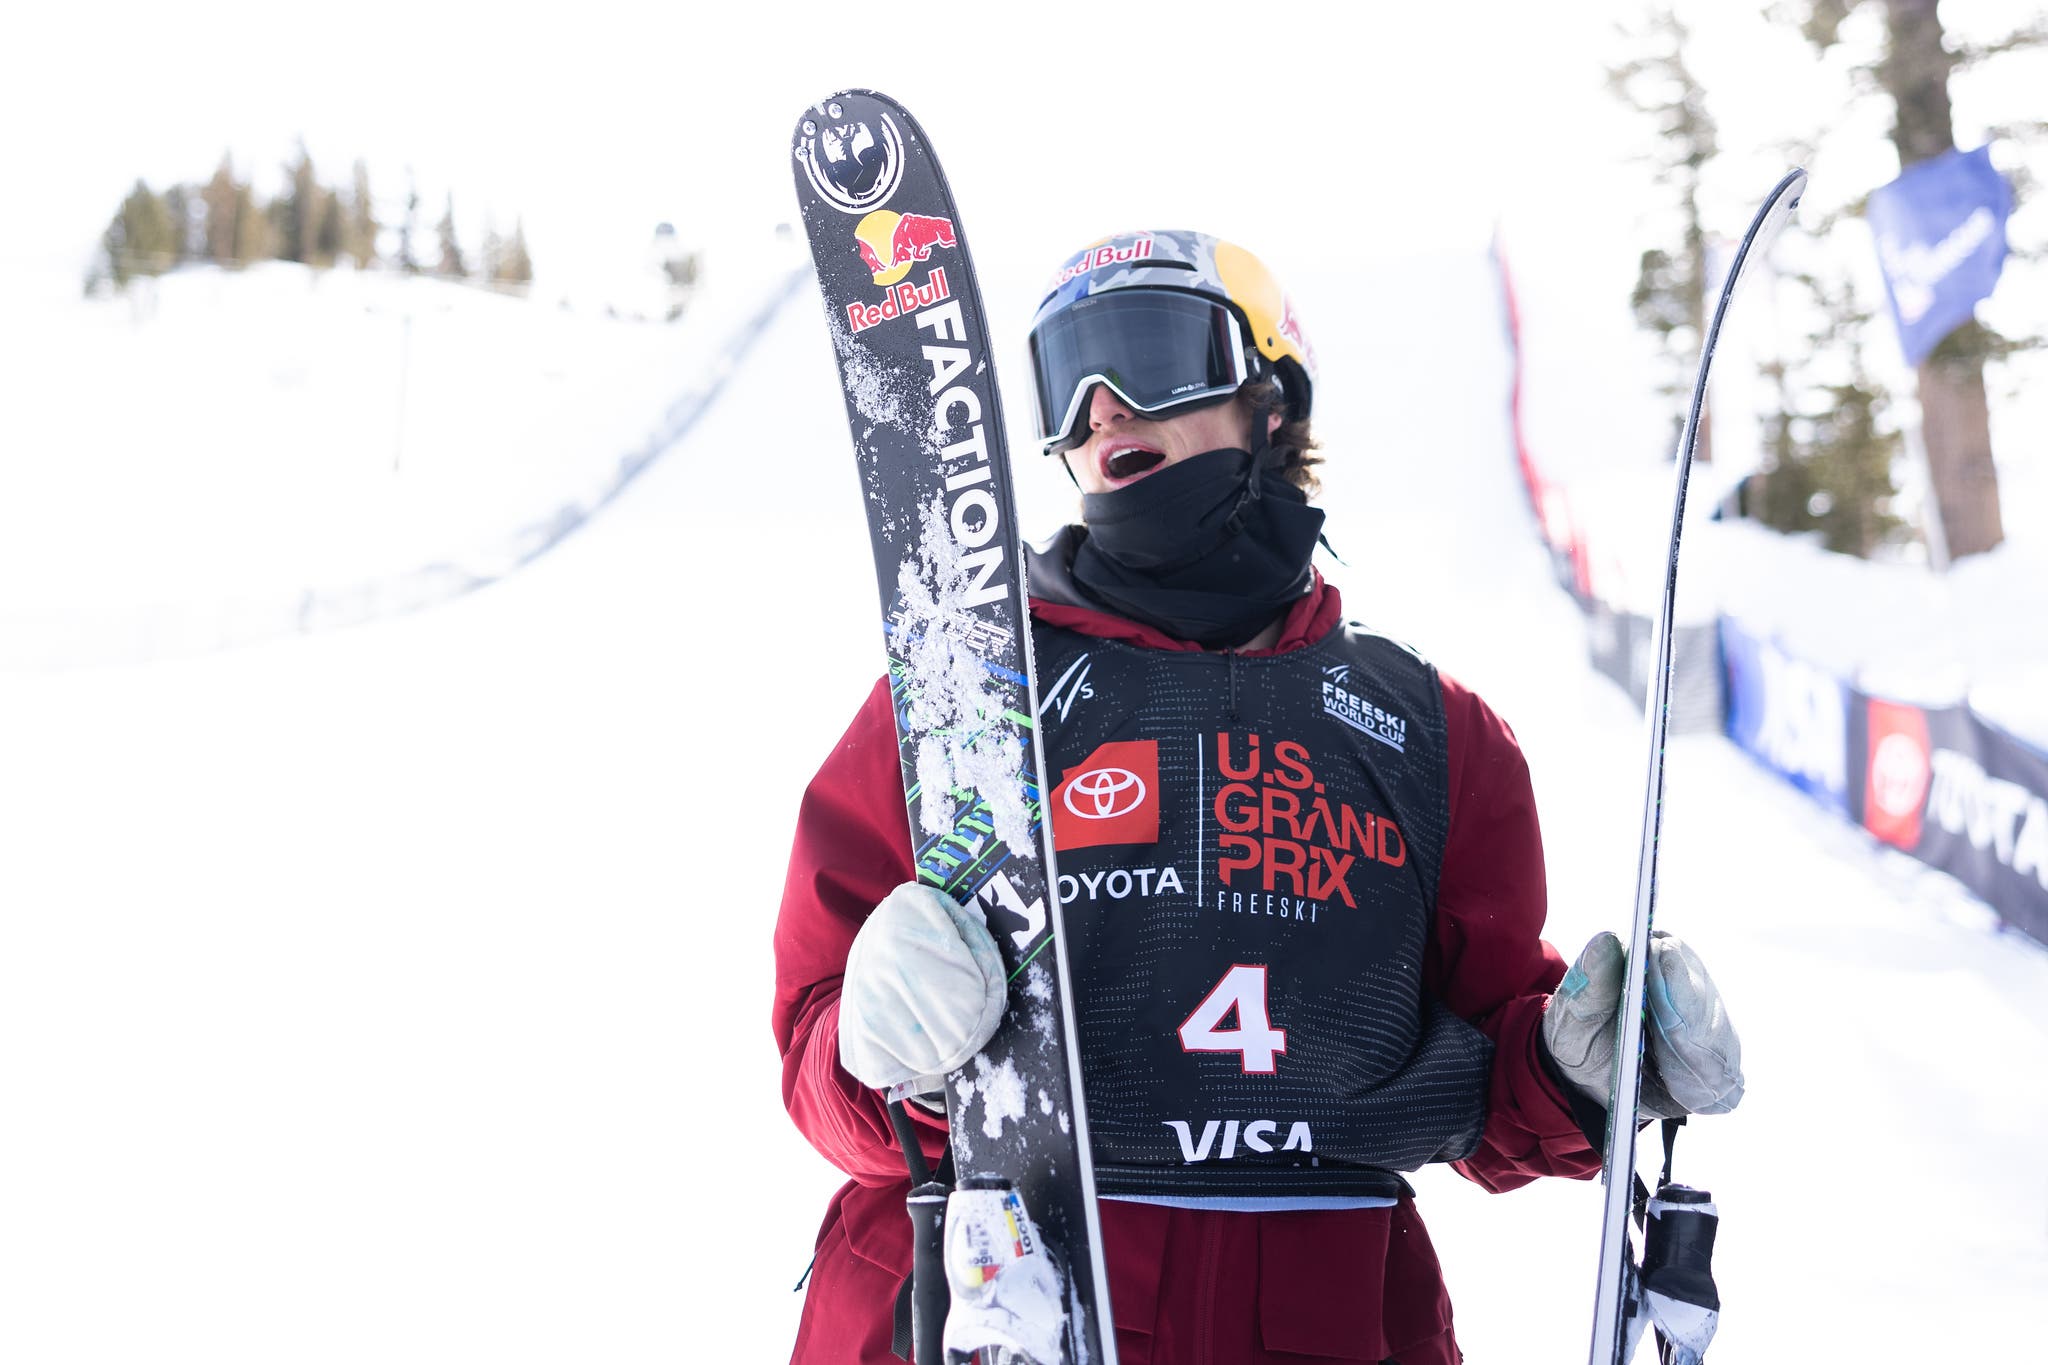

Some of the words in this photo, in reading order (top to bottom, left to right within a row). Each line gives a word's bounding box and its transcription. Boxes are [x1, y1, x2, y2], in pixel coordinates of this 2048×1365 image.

[1094, 239, 1152, 268] Bull
[847, 287, 899, 333] Red
[898, 266, 950, 314] Bull
[915, 300, 1009, 609] FACTION
[1322, 681, 1406, 734] FREESKI
[1323, 695, 1376, 729] WORLD
[1379, 723, 1406, 744] CUP
[1217, 732, 1325, 793] U.S.
[1214, 783, 1406, 868] GRAND
[1058, 866, 1184, 904] OYOTA
[1218, 891, 1317, 923] FREESKI
[1177, 963, 1288, 1075] 4
